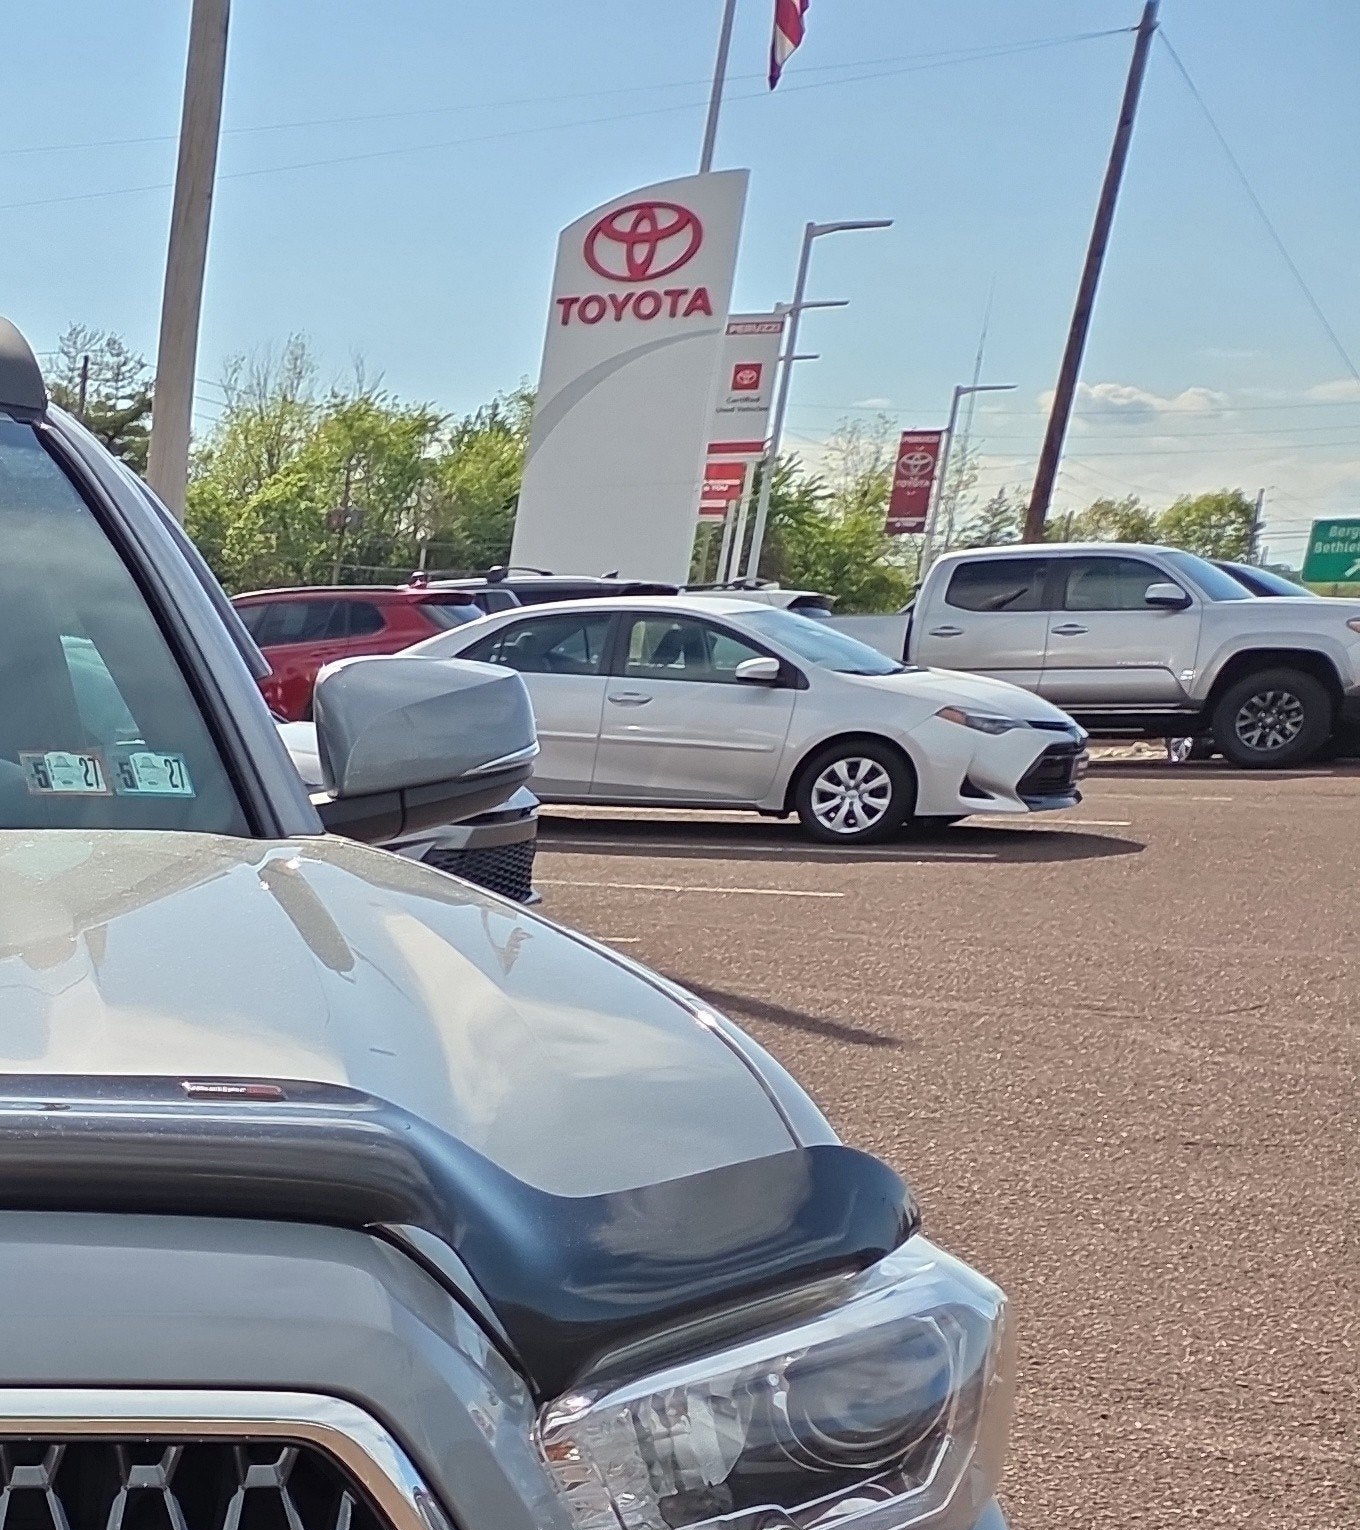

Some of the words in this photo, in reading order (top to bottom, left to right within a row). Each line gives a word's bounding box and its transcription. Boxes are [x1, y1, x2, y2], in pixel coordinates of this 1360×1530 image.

[556, 286, 713, 326] TOYOTA
[1314, 541, 1360, 554] Bethle
[1329, 525, 1360, 540] Berg
[78, 757, 100, 789] 27
[163, 758, 185, 790] 27
